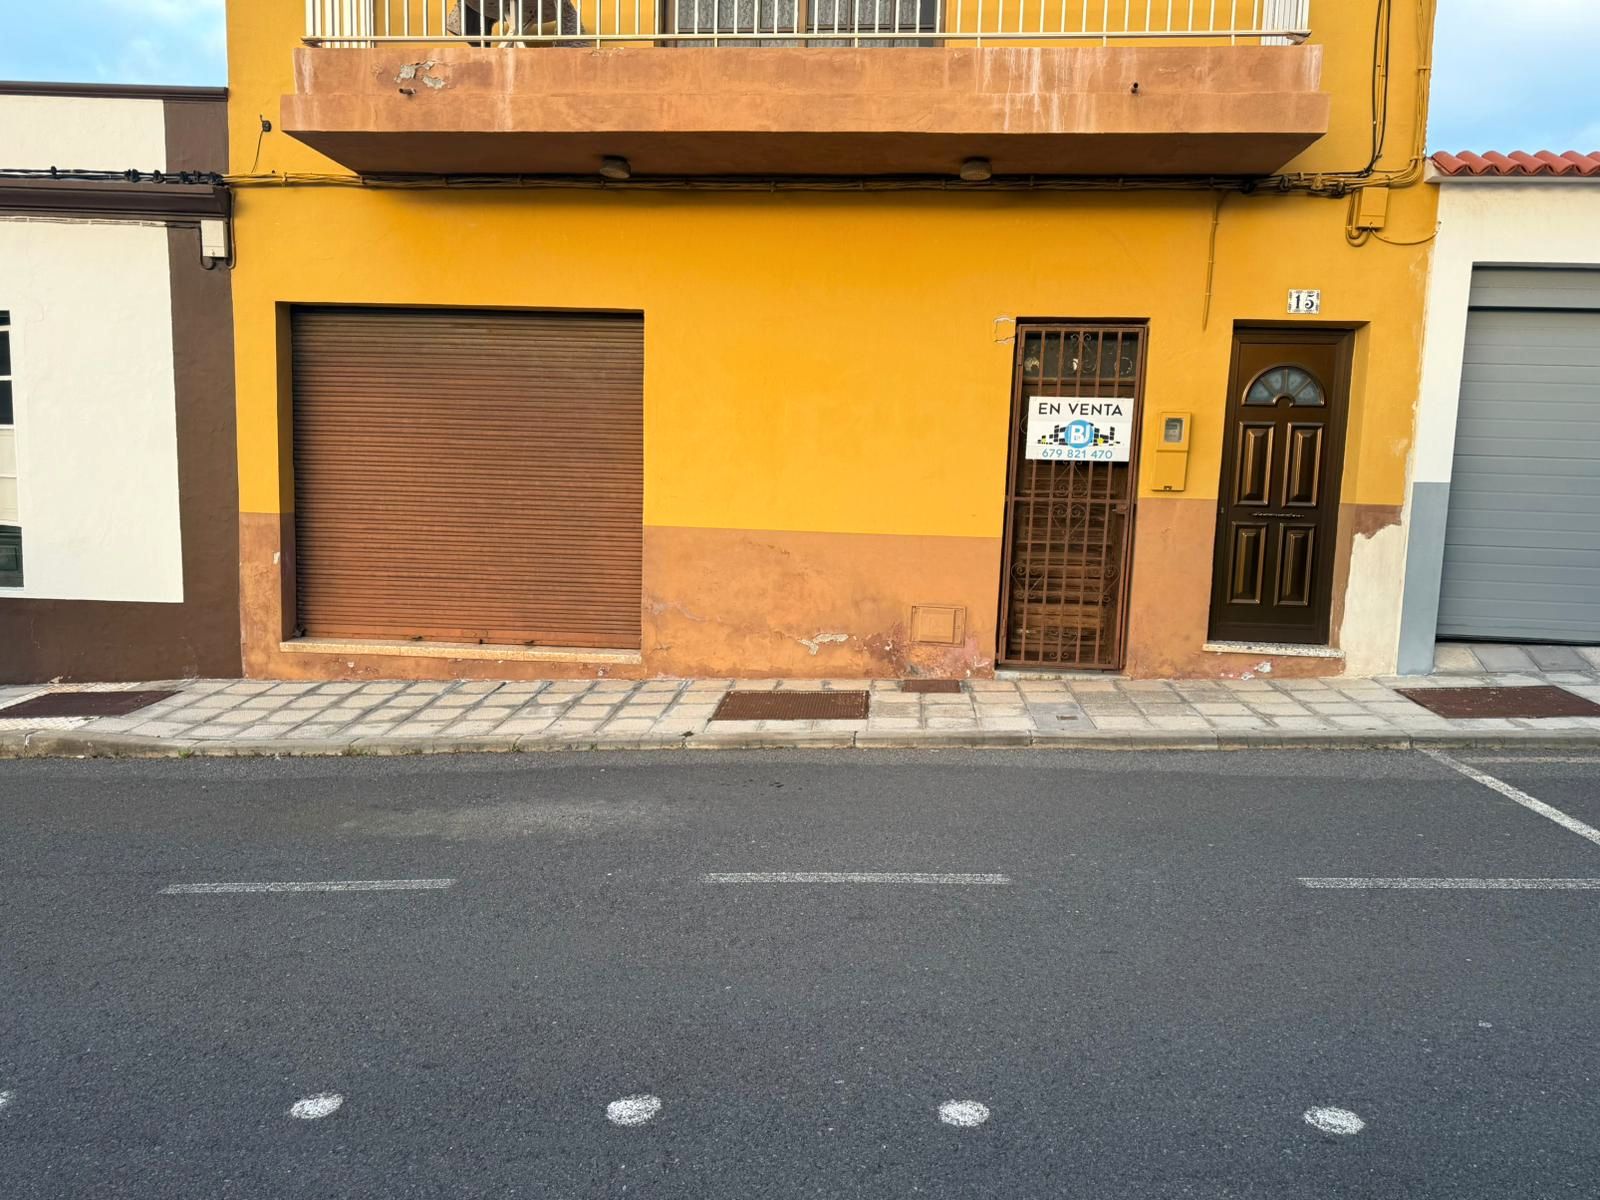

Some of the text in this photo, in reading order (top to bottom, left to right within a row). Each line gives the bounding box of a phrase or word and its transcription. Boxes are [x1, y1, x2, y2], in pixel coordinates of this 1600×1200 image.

[1295, 294, 1315, 310] 15
[1038, 402, 1123, 416] EN VENTA
[1042, 448, 1113, 459] 679 821 470
